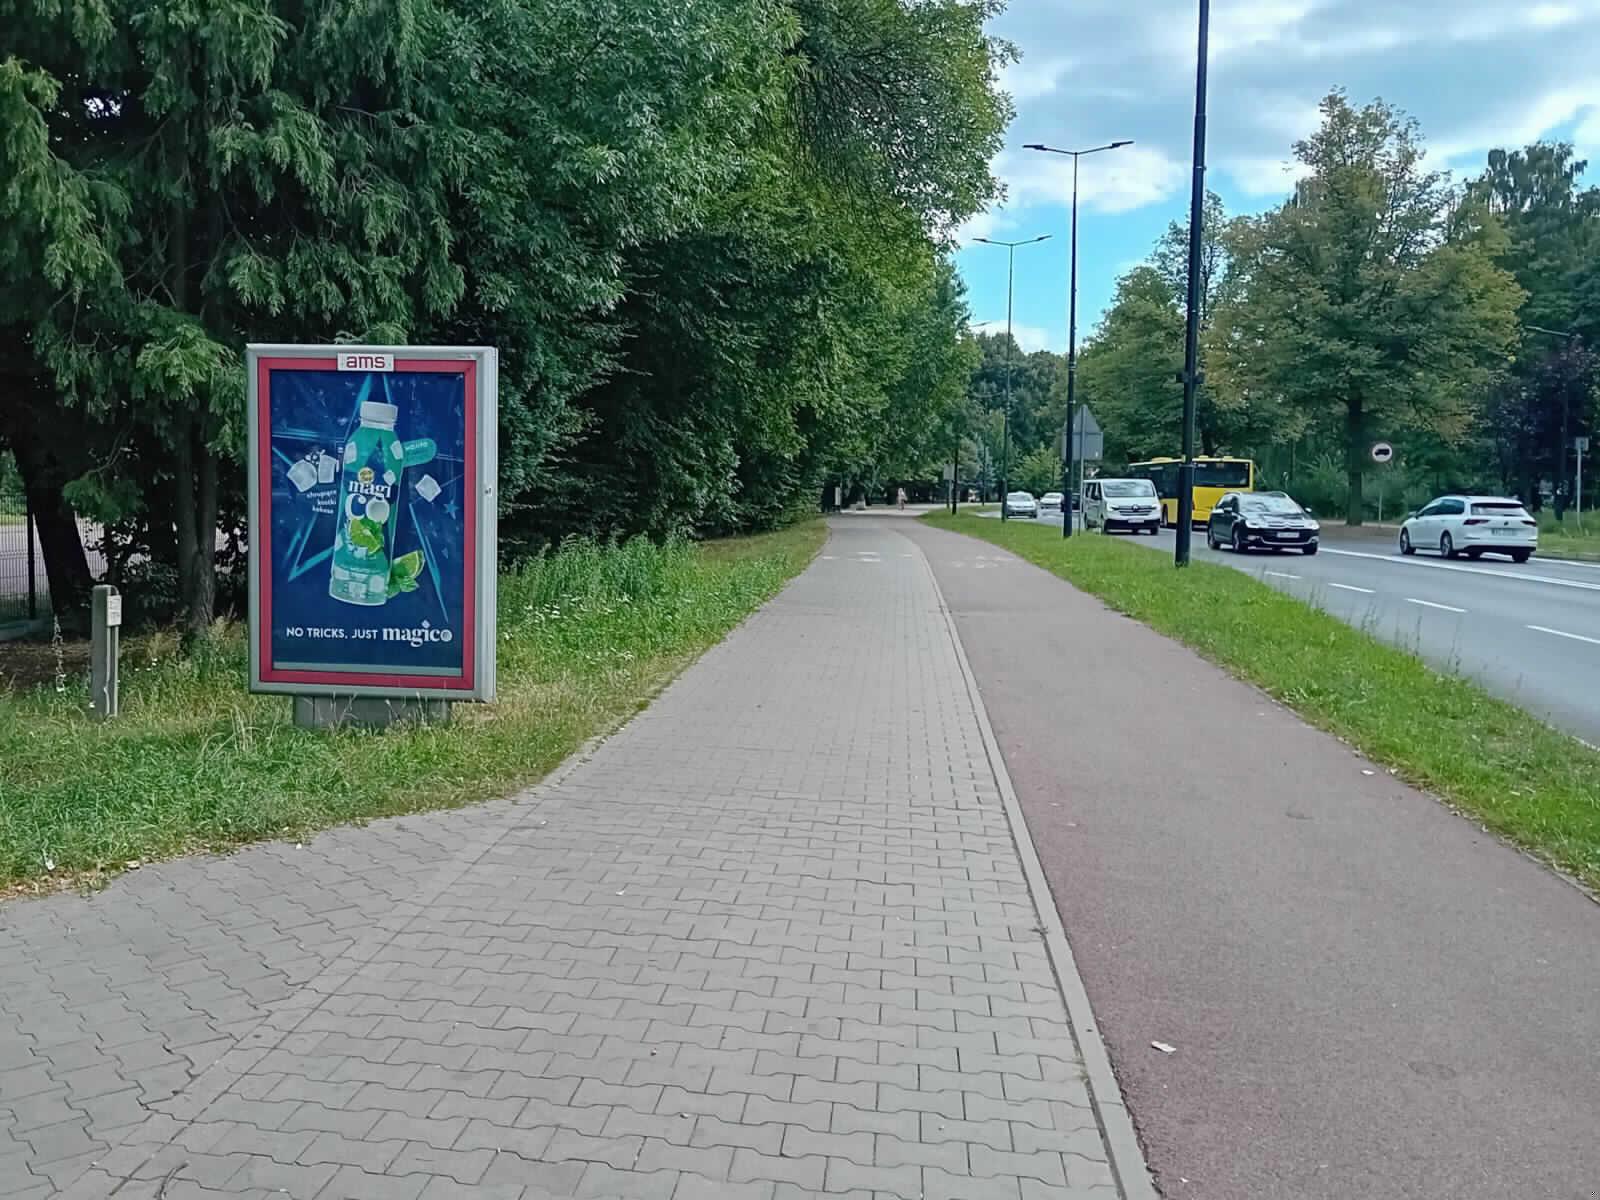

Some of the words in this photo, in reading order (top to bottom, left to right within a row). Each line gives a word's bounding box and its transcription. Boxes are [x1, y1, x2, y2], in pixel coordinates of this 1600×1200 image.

[346, 356, 385, 368] ams
[286, 627, 304, 637] NO
[306, 627, 348, 640] TRICKS.
[352, 629, 378, 640] JUST
[382, 619, 453, 648] magico
